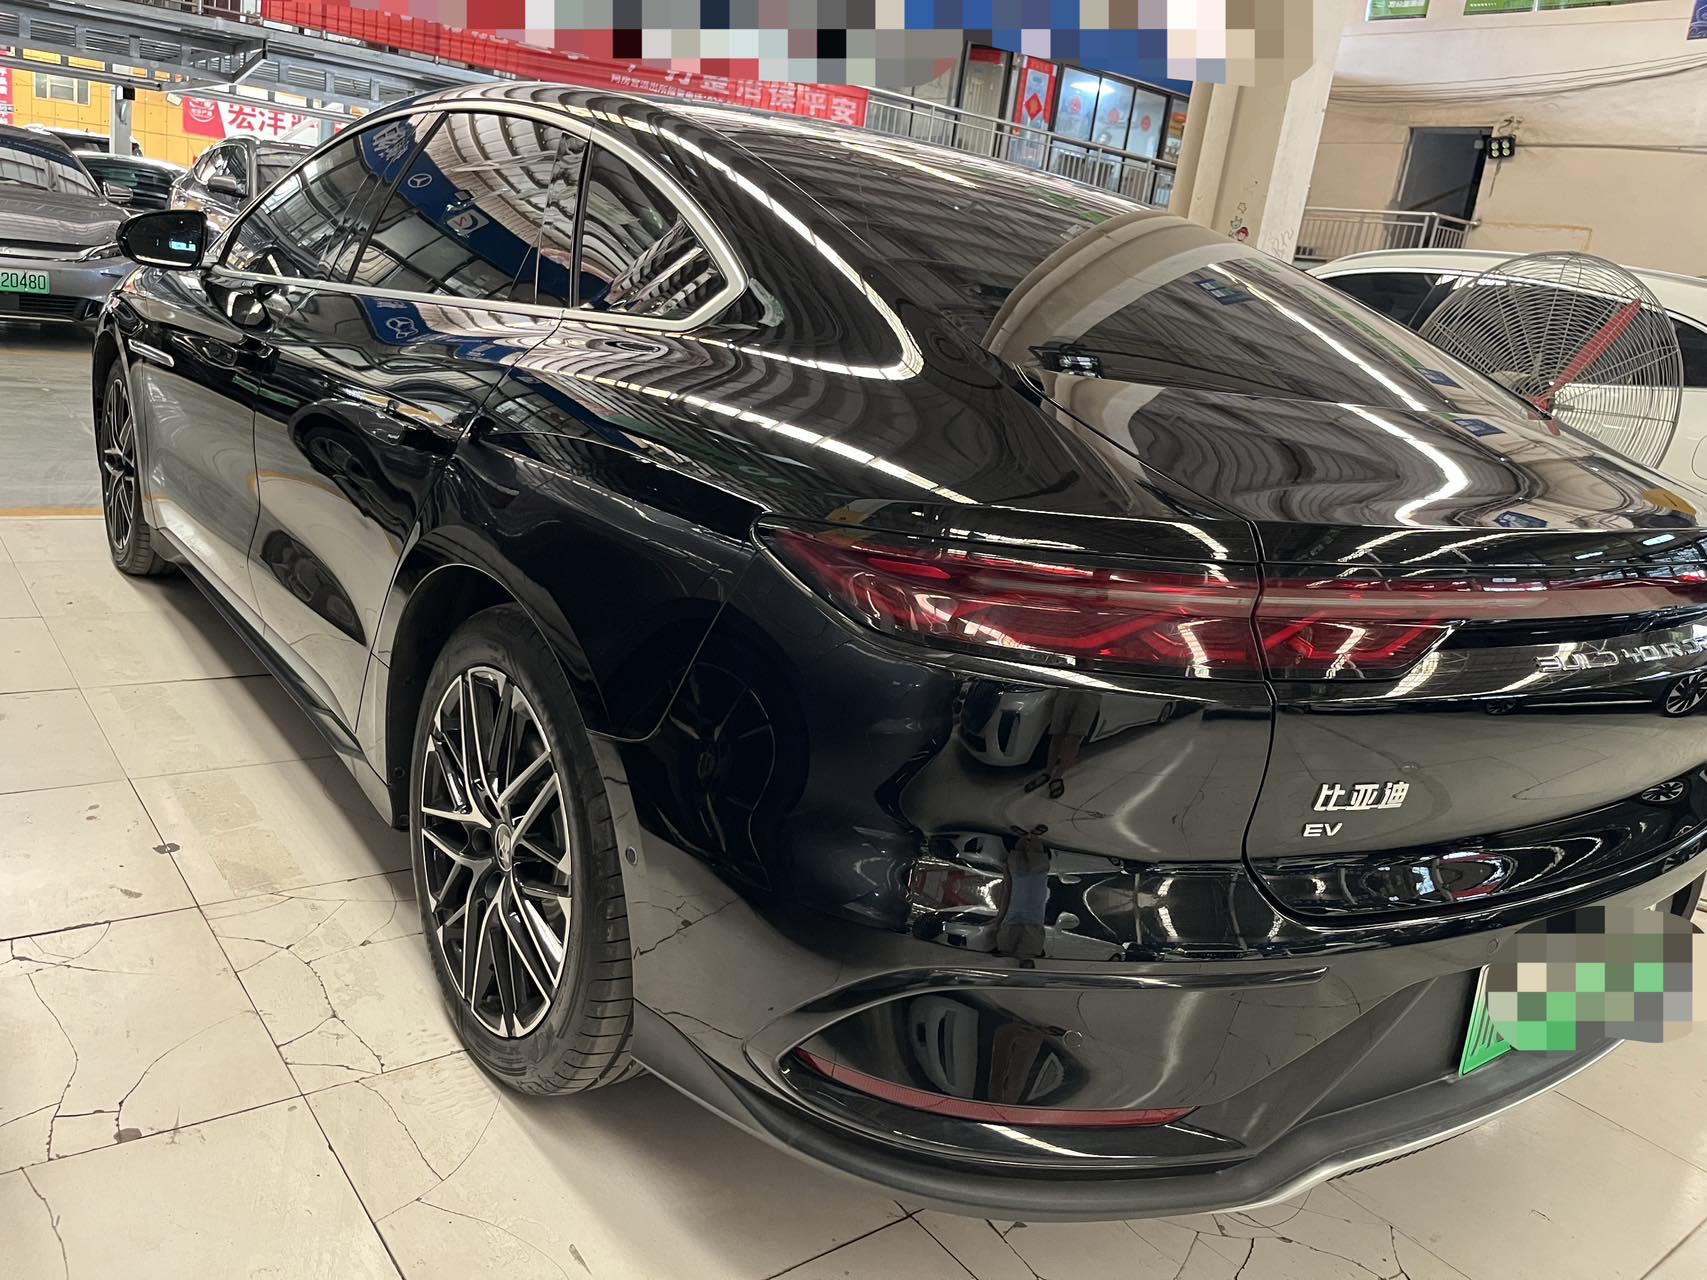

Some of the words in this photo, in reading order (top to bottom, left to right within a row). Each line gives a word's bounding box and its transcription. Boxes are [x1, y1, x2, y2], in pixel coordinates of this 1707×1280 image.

[1, 272, 46, 290] 20480
[1621, 643, 1684, 663] YOUR
[1313, 781, 1410, 811] 比亚迪
[1303, 822, 1343, 837] EV
